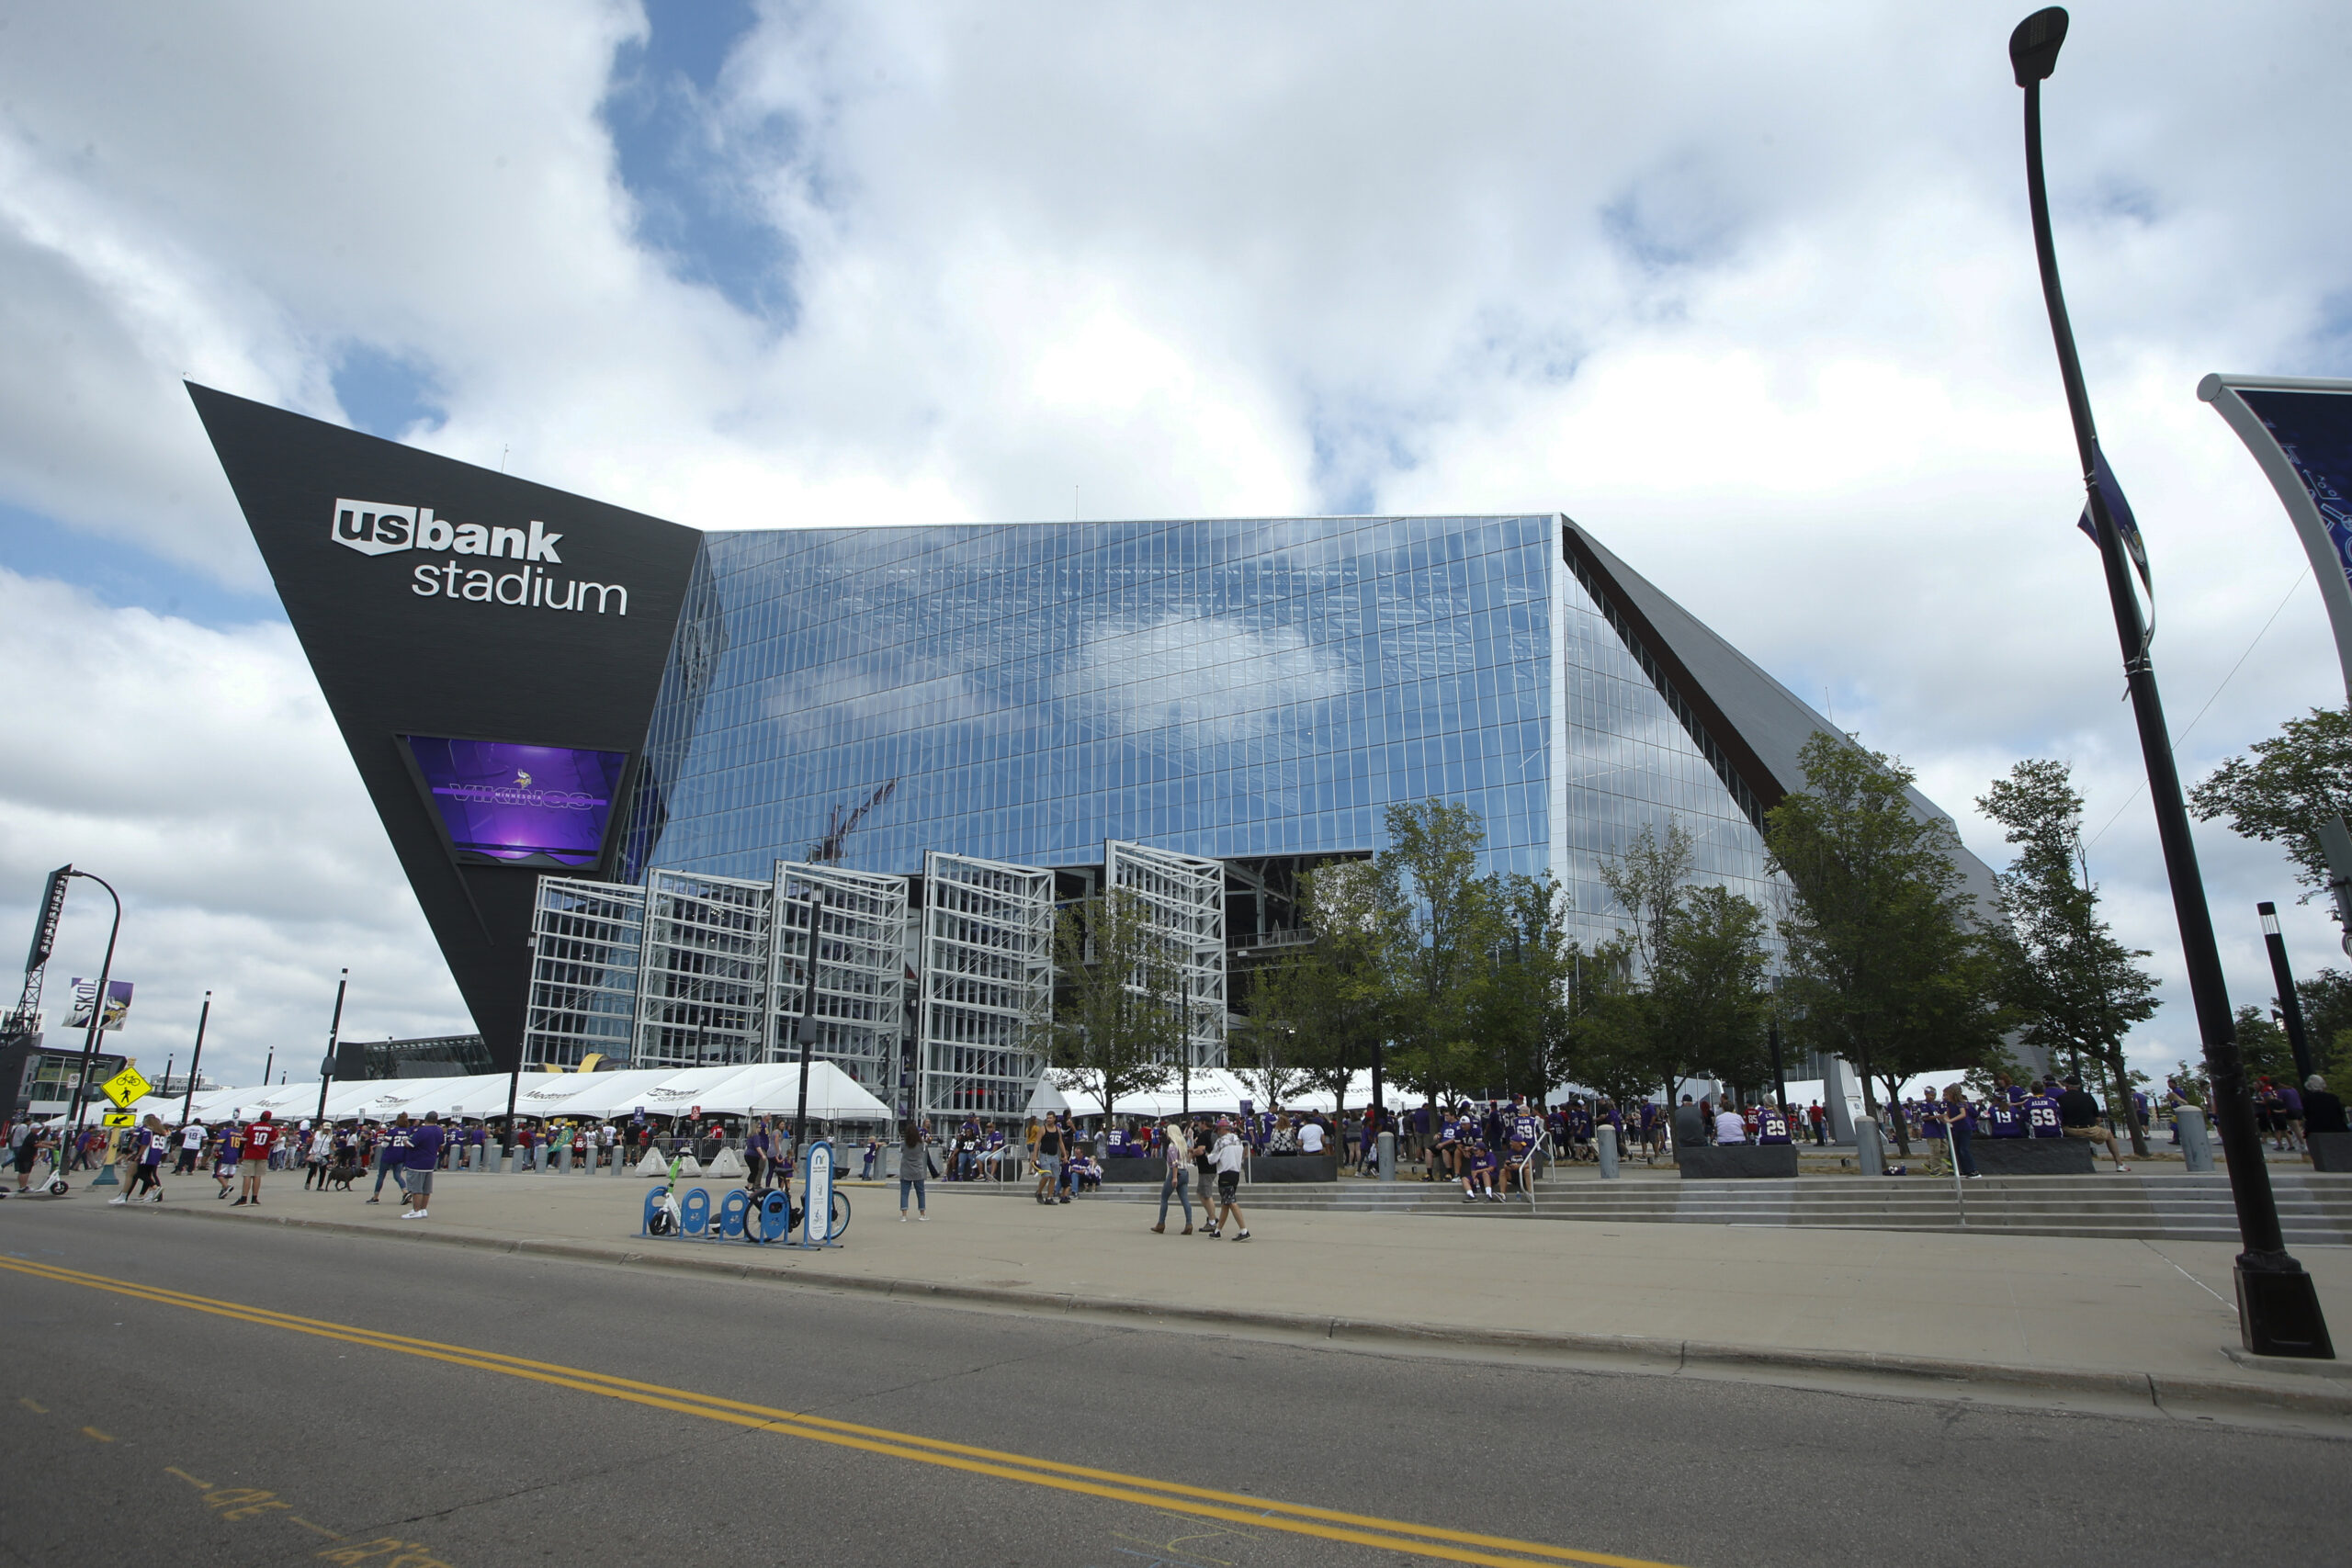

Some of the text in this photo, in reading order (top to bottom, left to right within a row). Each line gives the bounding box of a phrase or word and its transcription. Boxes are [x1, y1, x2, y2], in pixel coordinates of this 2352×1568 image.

[412, 560, 628, 615] stadium
[448, 783, 594, 810] VIKINGS
[495, 792, 542, 800] MINNESOTA
[74, 979, 96, 1012] SKOL
[1150, 1086, 1226, 1097] edronic
[2030, 1108, 2056, 1126] 69
[1517, 1124, 1532, 1139] 69
[1766, 1120, 1787, 1136] 29
[152, 1134, 165, 1149] 69
[254, 1133, 269, 1146] 10
[1109, 1134, 1121, 1145] 35
